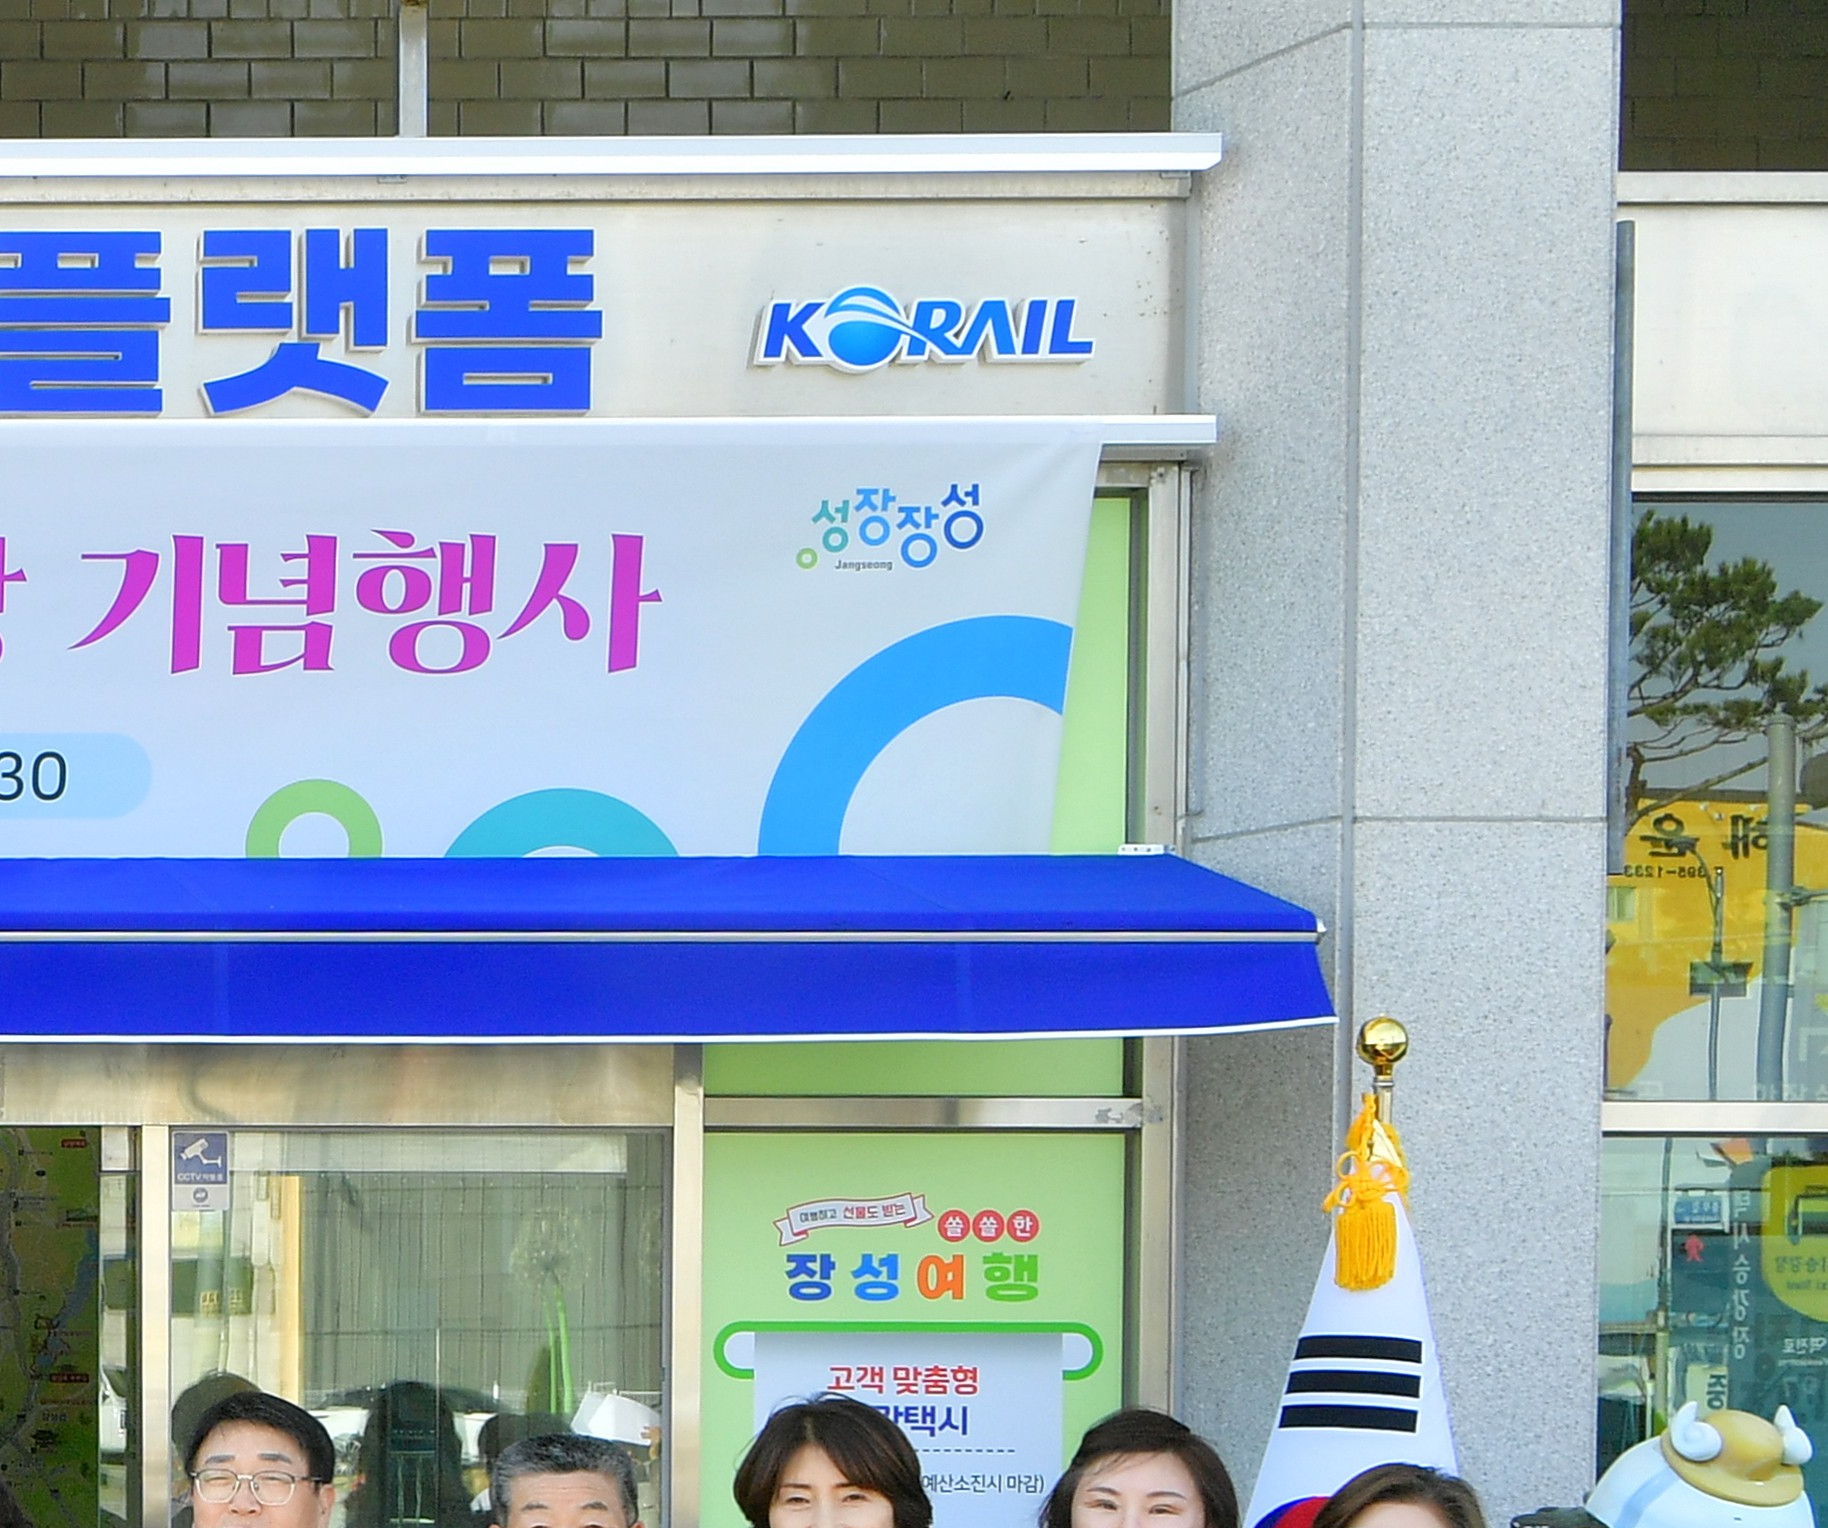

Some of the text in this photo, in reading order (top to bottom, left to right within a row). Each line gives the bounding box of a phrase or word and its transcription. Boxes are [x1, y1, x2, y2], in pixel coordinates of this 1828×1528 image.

[760, 290, 1093, 372] KORAIL
[795, 482, 985, 572] 성장장성
[834, 557, 895, 572] Jangseong
[67, 533, 664, 677] 기념행사
[843, 1204, 879, 1220] 선물도
[882, 1202, 907, 1218] 받는
[827, 1366, 980, 1396] 고객 맞춤형
[1007, 1474, 1045, 1495] 마감)
